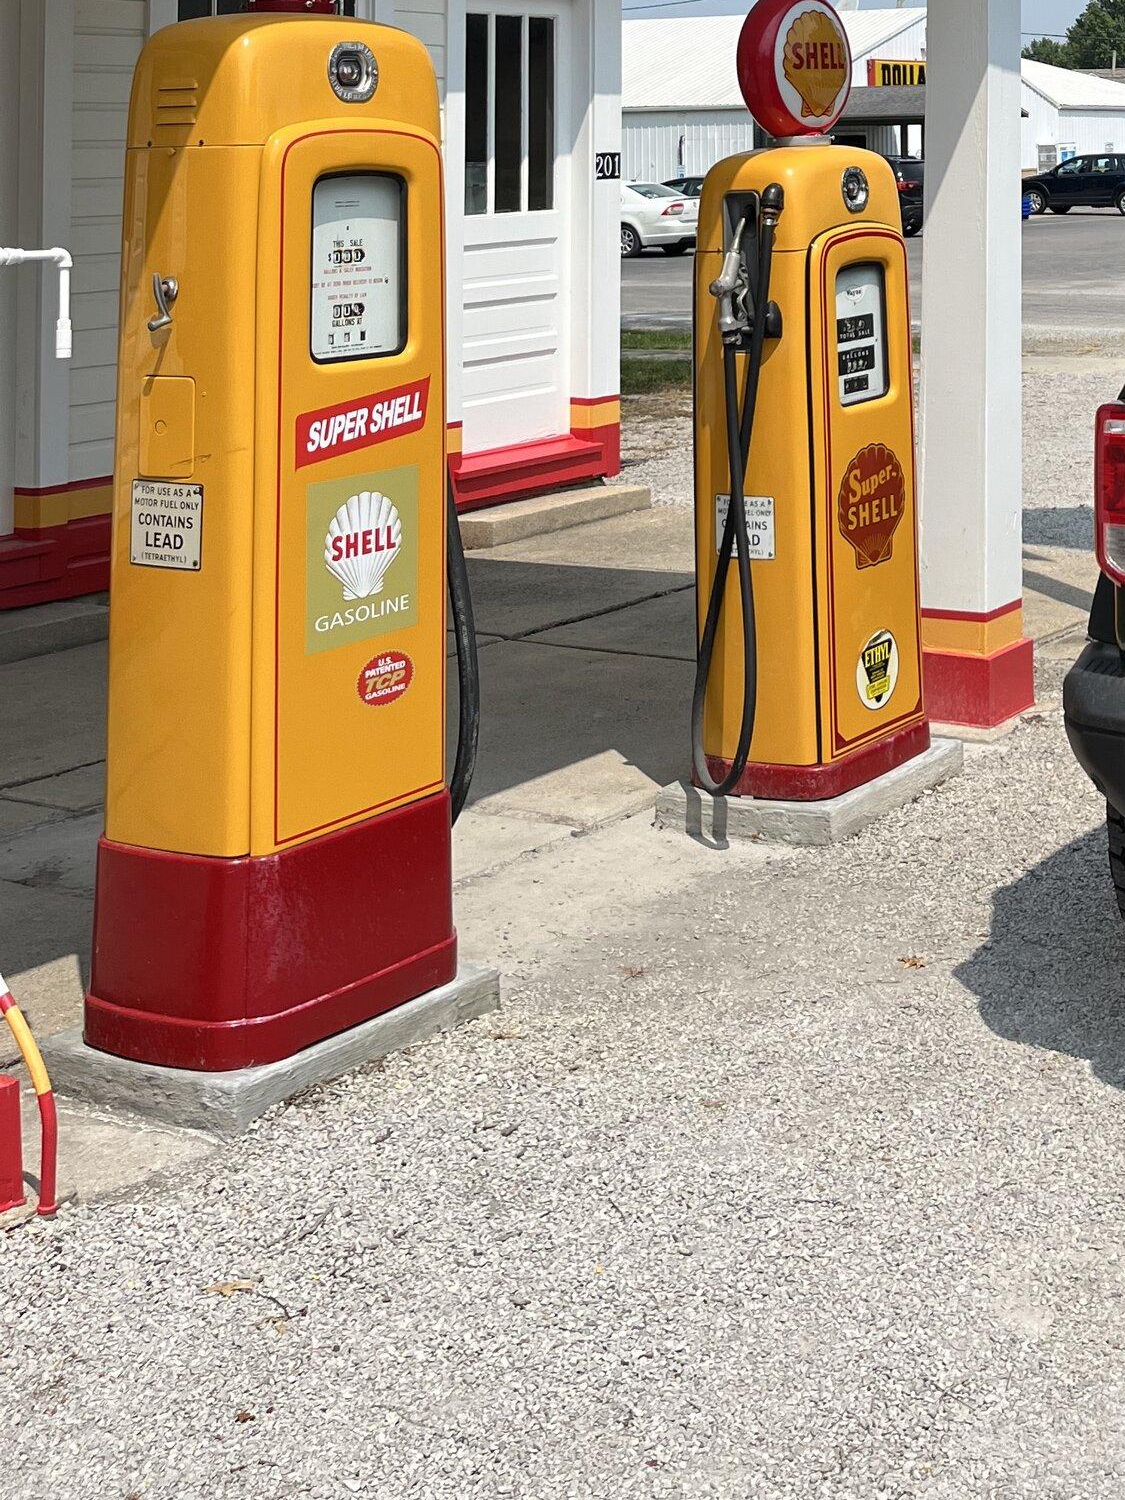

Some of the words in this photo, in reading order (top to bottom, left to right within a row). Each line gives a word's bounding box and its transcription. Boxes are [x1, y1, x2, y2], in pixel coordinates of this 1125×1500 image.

[791, 42, 845, 71] SHELL
[881, 63, 926, 86] DOLLA
[596, 154, 620, 177] 201
[333, 240, 344, 248] THIS
[350, 238, 363, 247] SALE
[332, 318, 355, 327] GALLONS
[840, 330, 856, 340] TOTAL
[858, 329, 871, 337] SALE
[842, 351, 869, 360] GALLONS
[306, 407, 369, 453] SUPER
[369, 391, 423, 433] SHELL
[141, 485, 155, 494] FOR
[157, 487, 171, 496] USE
[173, 488, 184, 497] AS
[186, 489, 192, 497] A
[134, 497, 158, 507] MOTOR
[160, 500, 178, 509] FUEL
[180, 501, 199, 510] ONLY
[847, 494, 898, 531] SHELL
[138, 512, 193, 529] CONTAINS
[145, 531, 184, 550] LEAD
[331, 525, 397, 562] SHELL
[141, 552, 187, 564] (TETRAETHYL)
[314, 594, 410, 633] GASOLINE
[377, 656, 393, 667] U.S.
[864, 641, 890, 668] ETHYL
[365, 660, 406, 679] PATENTED
[365, 670, 406, 693] TCP
[364, 683, 406, 701] GASOLINE
